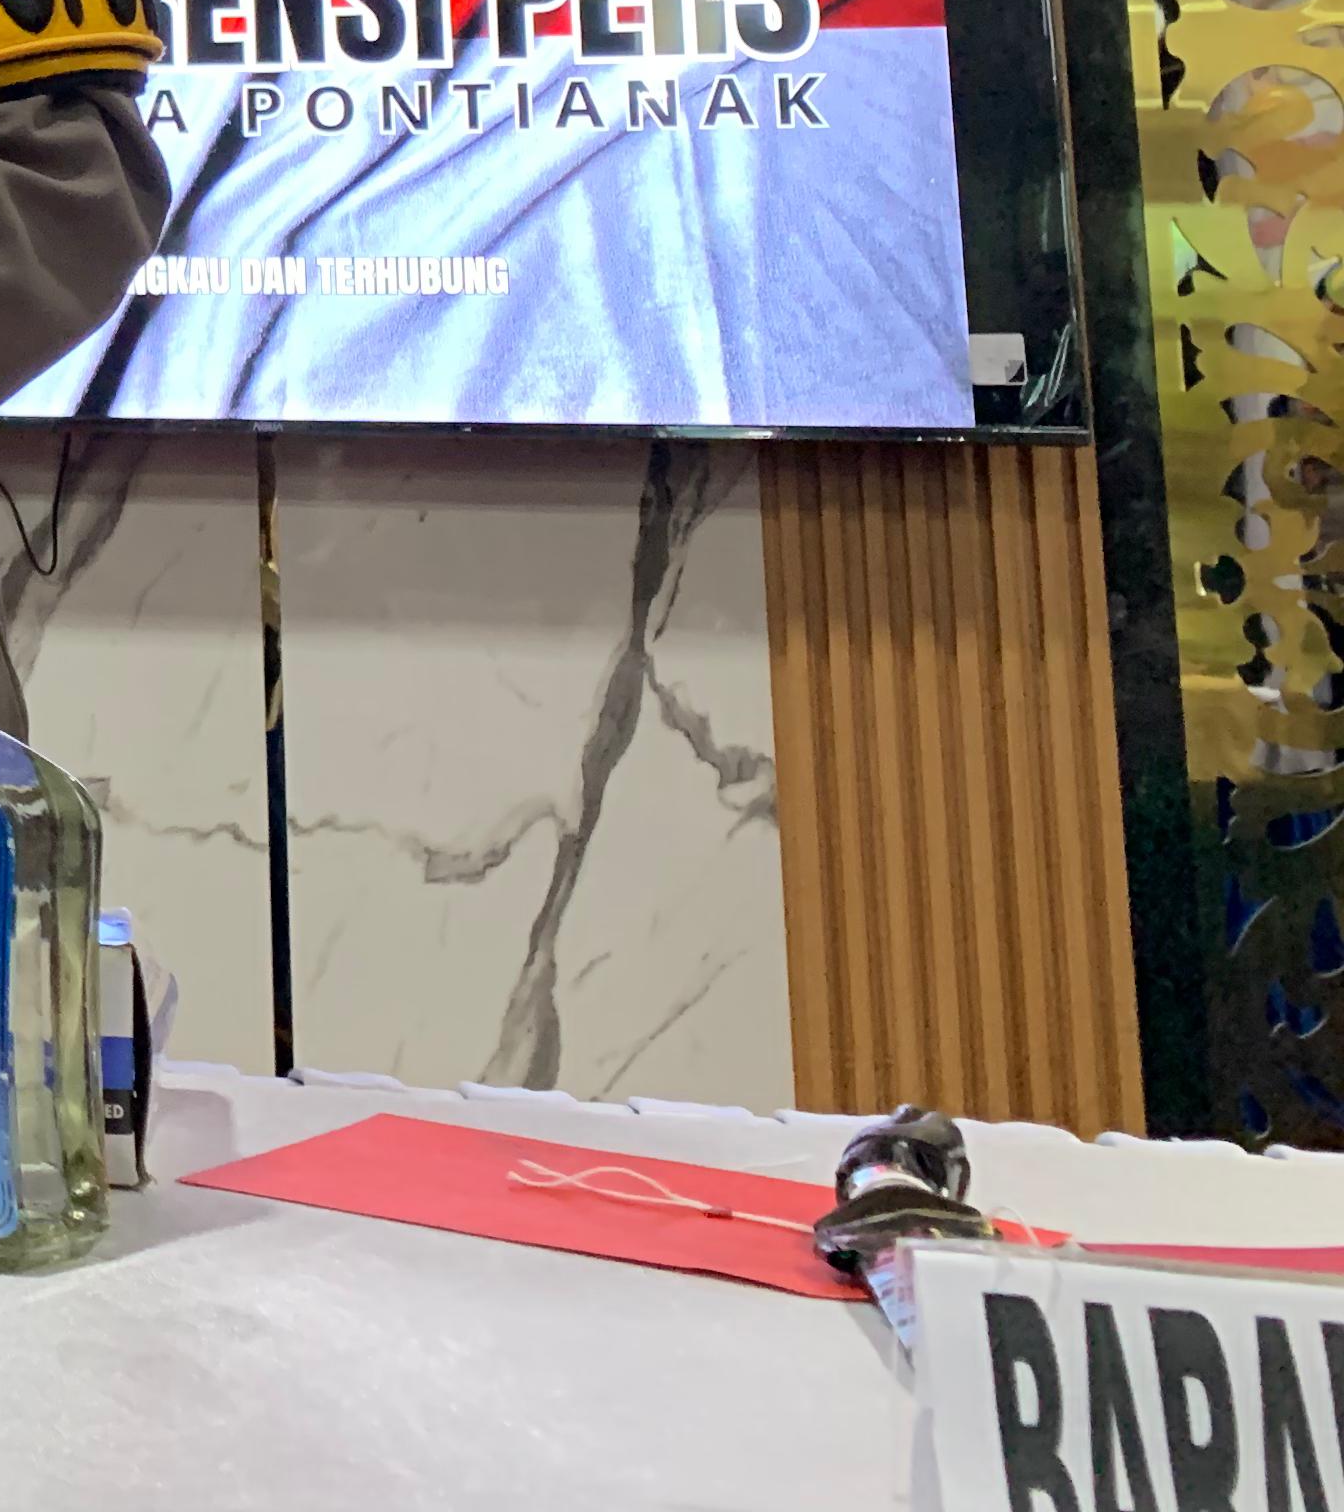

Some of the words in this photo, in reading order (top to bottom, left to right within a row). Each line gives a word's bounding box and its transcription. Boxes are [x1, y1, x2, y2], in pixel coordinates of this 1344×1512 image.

[243, 74, 830, 136] PONTIANAK
[241, 257, 307, 296] DAN
[317, 256, 511, 296] TERHUBUNG
[105, 1104, 124, 1119] ED
